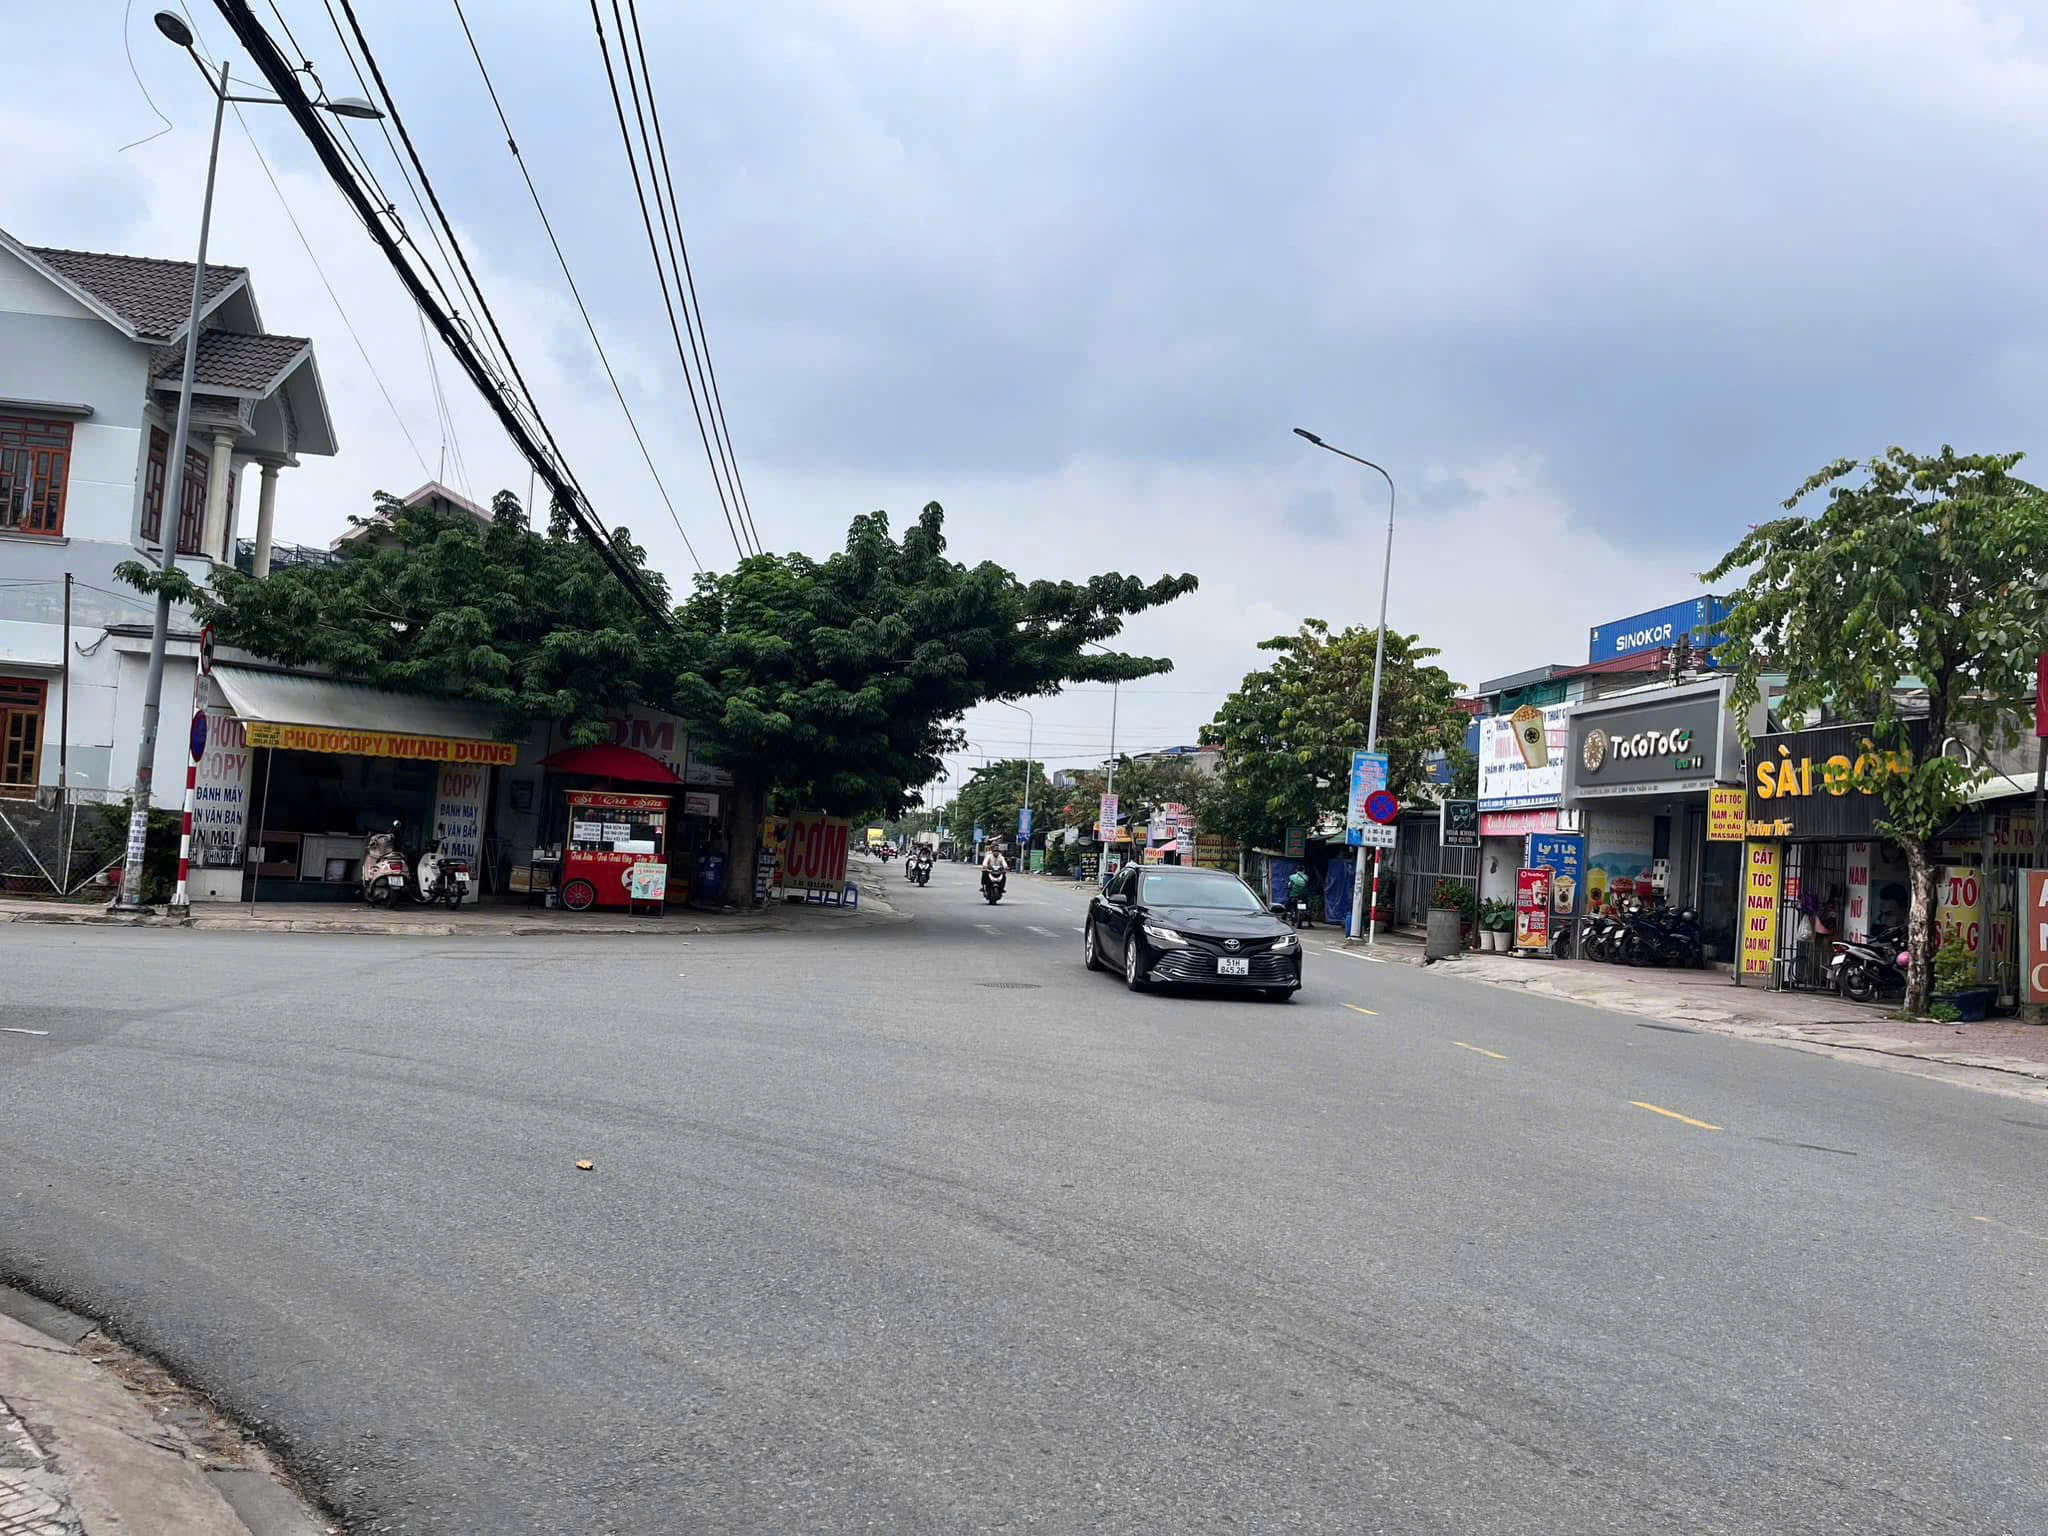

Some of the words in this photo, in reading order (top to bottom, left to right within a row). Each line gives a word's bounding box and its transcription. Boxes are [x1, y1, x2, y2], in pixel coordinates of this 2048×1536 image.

[1616, 624, 1672, 651] SINOKOR
[284, 730, 382, 754] PHOTOCOPY
[391, 739, 448, 758] MINH
[200, 752, 247, 782] COPY
[1756, 744, 1813, 799] SÀI
[224, 786, 243, 803] MÁY
[443, 774, 481, 798] COPY
[1711, 810, 1727, 819] NAM
[192, 829, 206, 844] IN
[788, 817, 848, 880] CƠM
[1752, 870, 1772, 887] TÓC
[1849, 866, 1867, 885] NAM
[1950, 870, 1980, 907] TÓ
[1747, 896, 1773, 909] NAM
[1751, 915, 1767, 931] NỮ
[1967, 922, 2006, 952] GN
